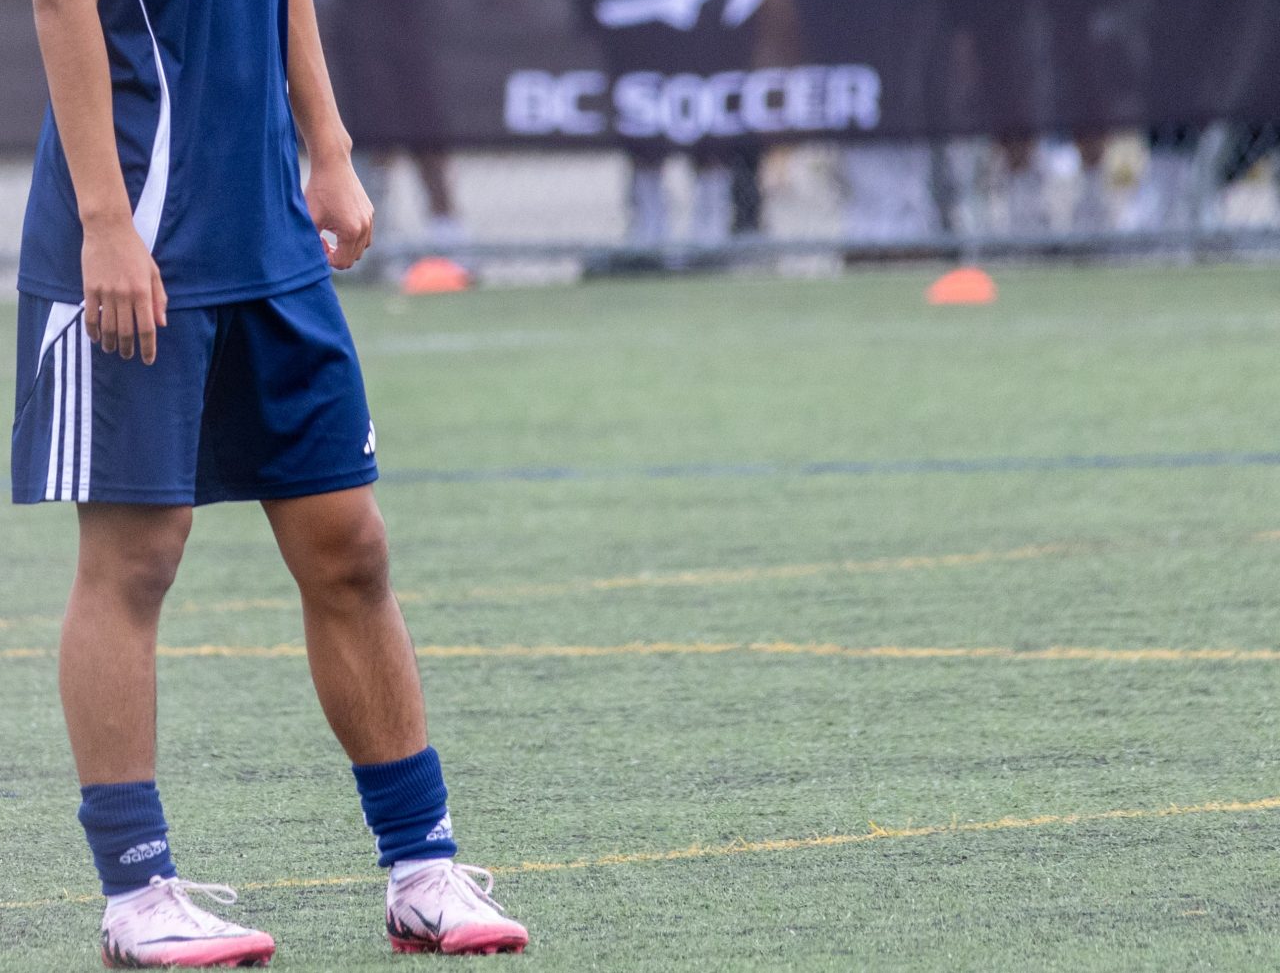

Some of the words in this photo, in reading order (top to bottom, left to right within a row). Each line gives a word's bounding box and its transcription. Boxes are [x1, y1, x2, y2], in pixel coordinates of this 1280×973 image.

[505, 68, 608, 134] BC
[613, 64, 881, 144] SOCCER
[120, 840, 167, 864] adidas
